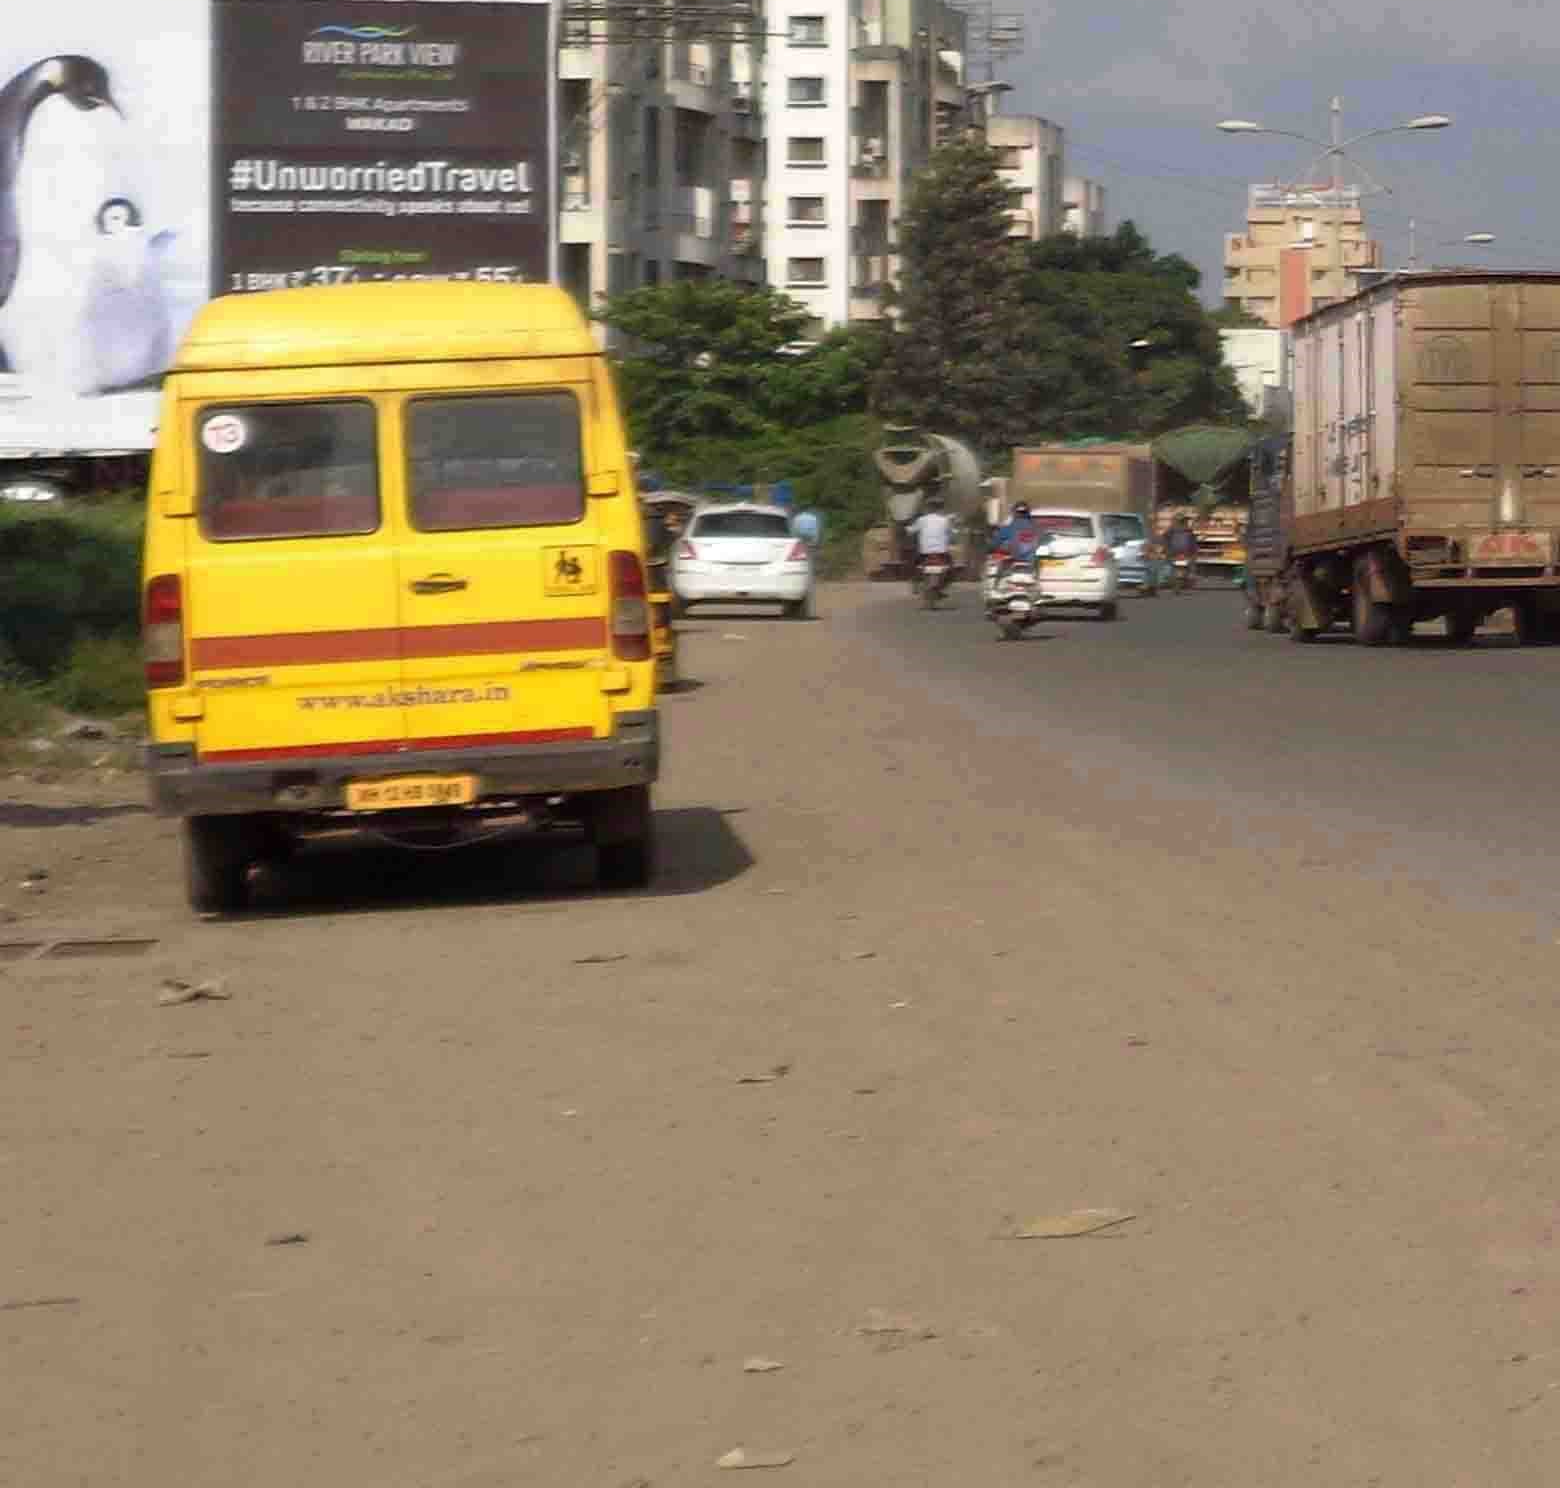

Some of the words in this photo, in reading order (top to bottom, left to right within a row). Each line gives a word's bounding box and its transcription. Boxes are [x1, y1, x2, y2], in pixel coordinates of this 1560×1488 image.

[303, 41, 353, 64] RIVER
[229, 159, 532, 193] #UnworriedTravel
[296, 680, 512, 712] www.akshara.in
